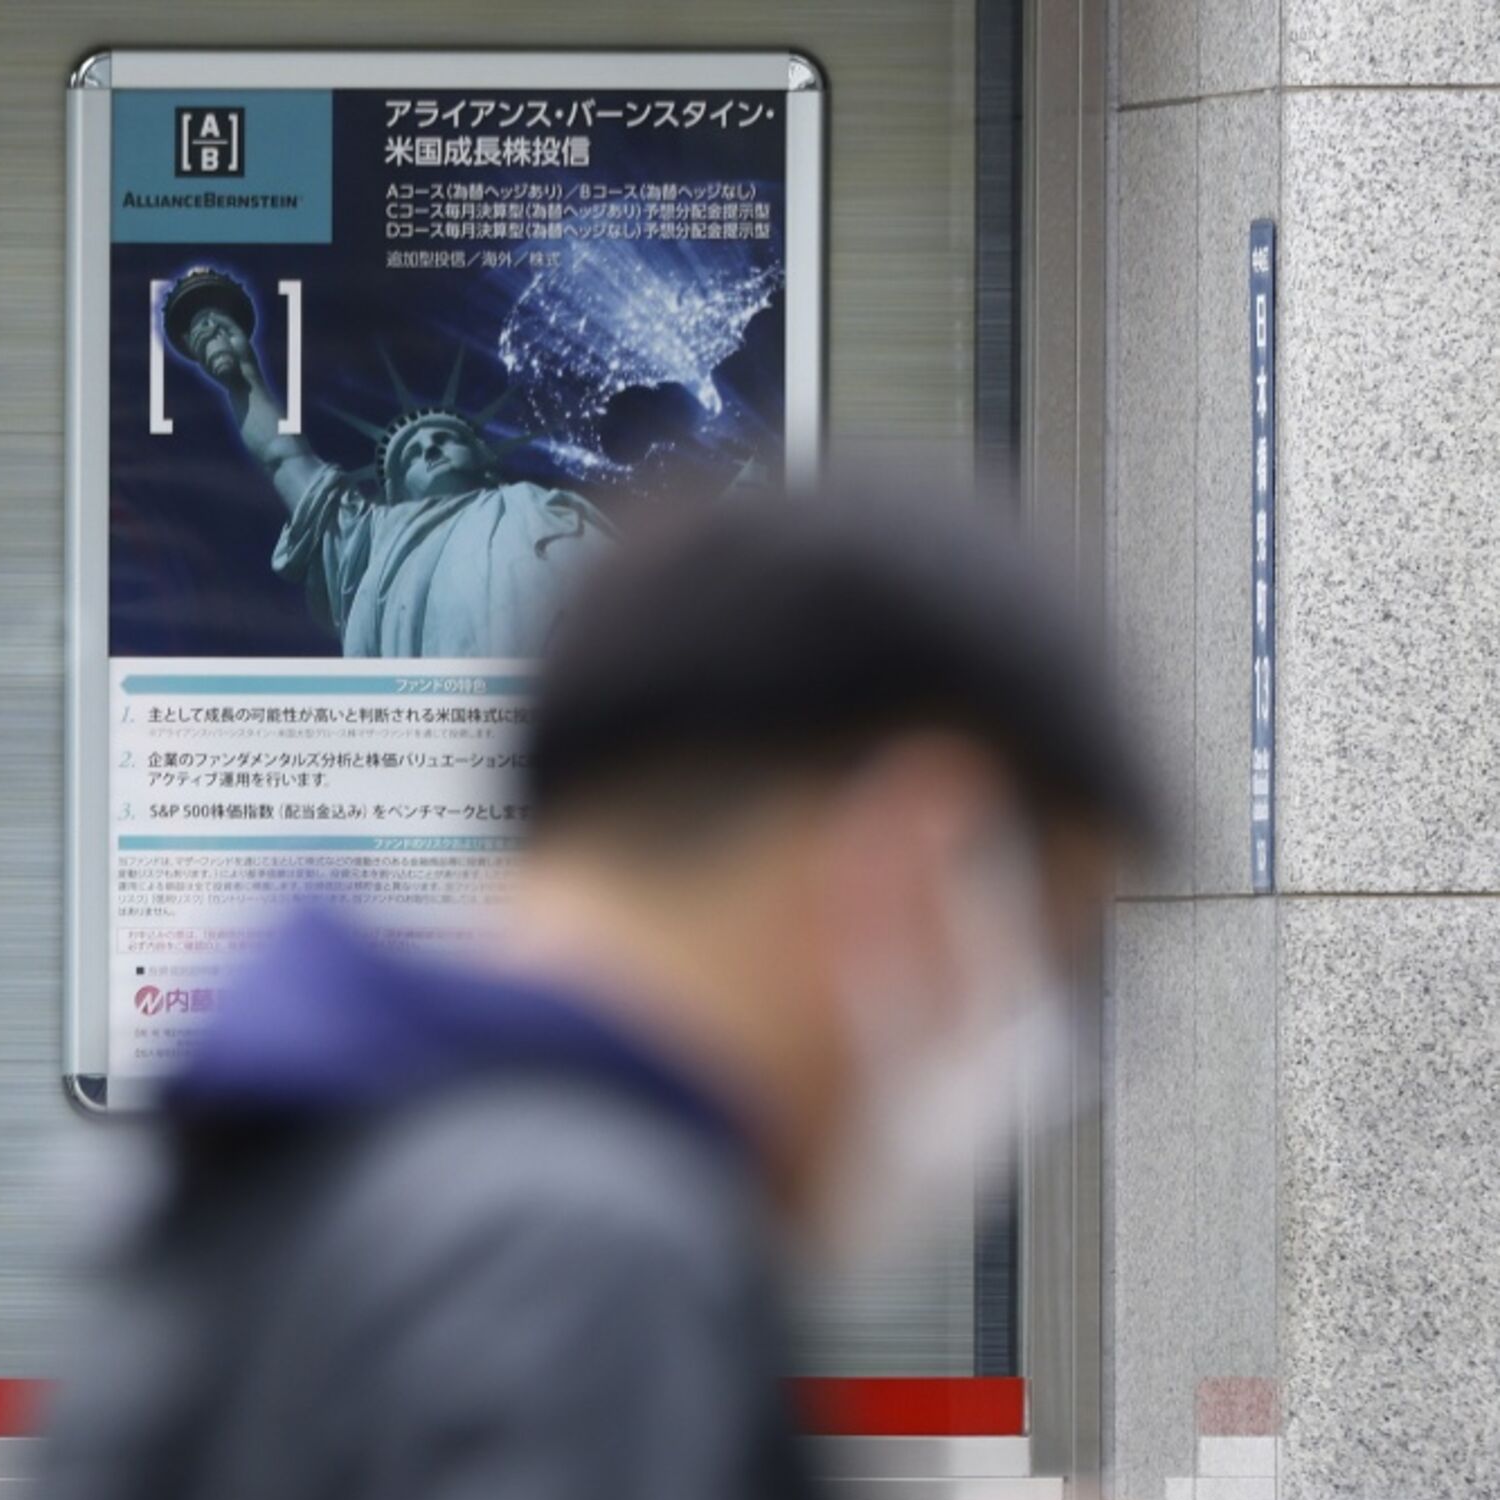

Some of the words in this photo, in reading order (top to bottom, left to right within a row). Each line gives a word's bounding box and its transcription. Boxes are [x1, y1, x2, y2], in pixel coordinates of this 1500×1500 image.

[200, 114, 220, 137] A
[385, 99, 775, 129] アライアンス・バーンスタイン・
[201, 147, 219, 171] B
[385, 136, 590, 167] 米国成長株投信
[395, 678, 488, 693] ファンドの特色
